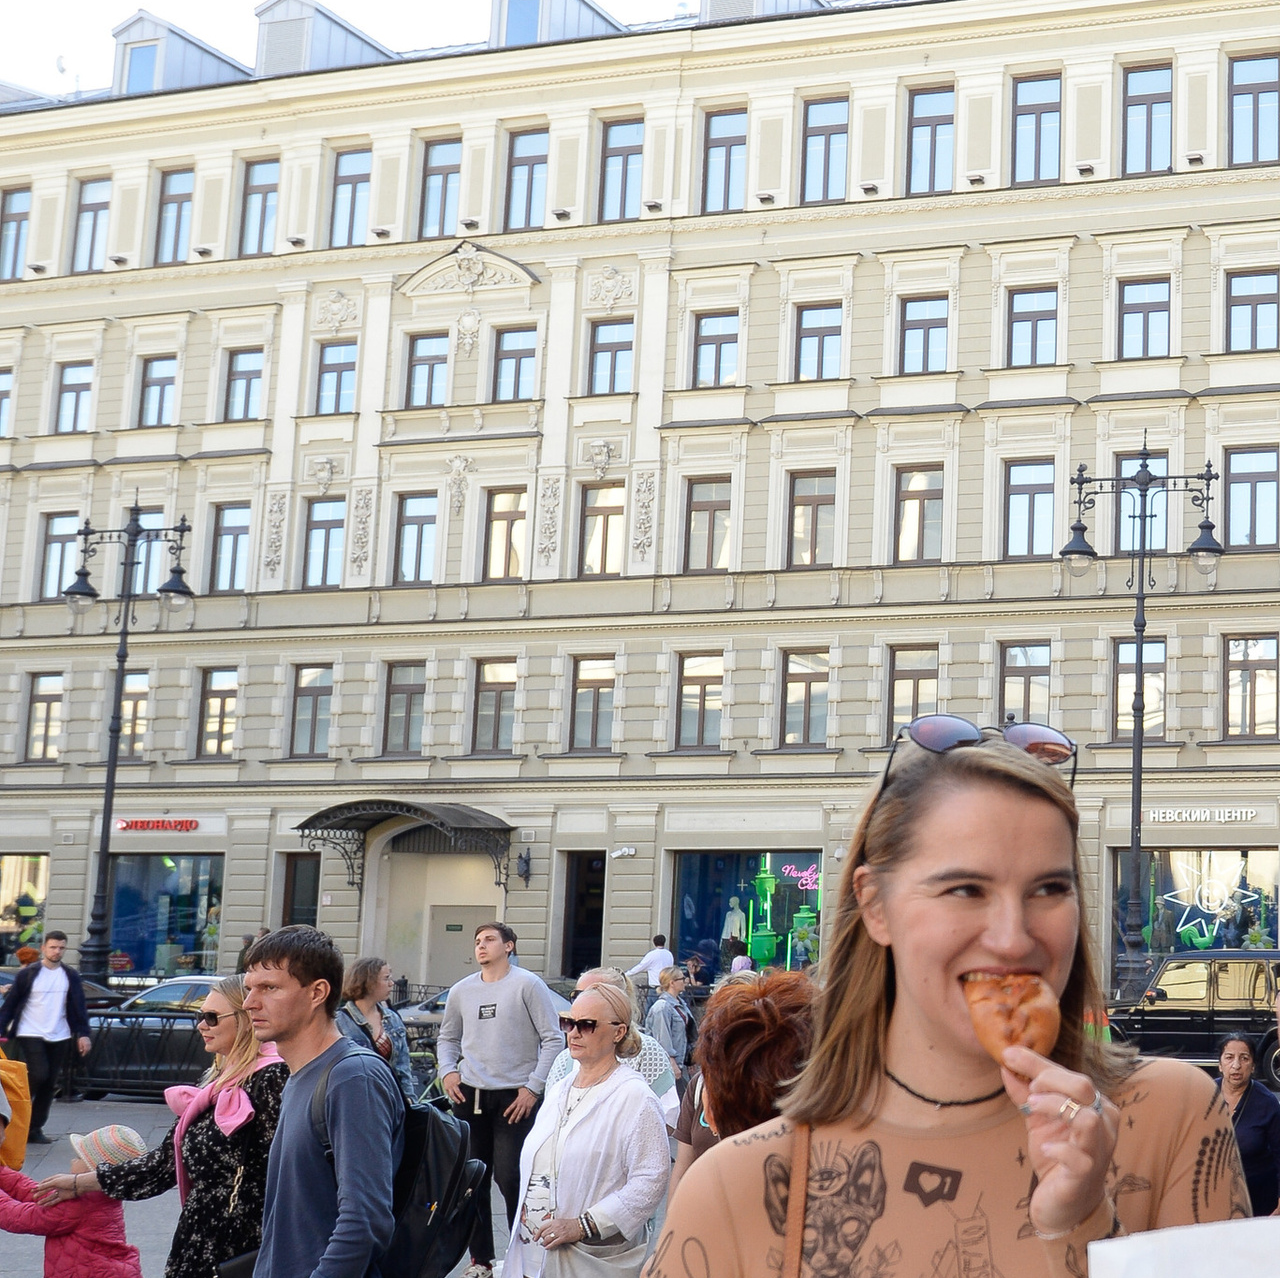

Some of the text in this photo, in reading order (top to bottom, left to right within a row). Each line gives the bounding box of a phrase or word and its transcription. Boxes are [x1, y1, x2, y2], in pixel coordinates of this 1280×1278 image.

[1149, 808, 1257, 823] НЕВСКИЙ ЦЕНТР
[127, 819, 199, 831] ЛЕОНАРДО
